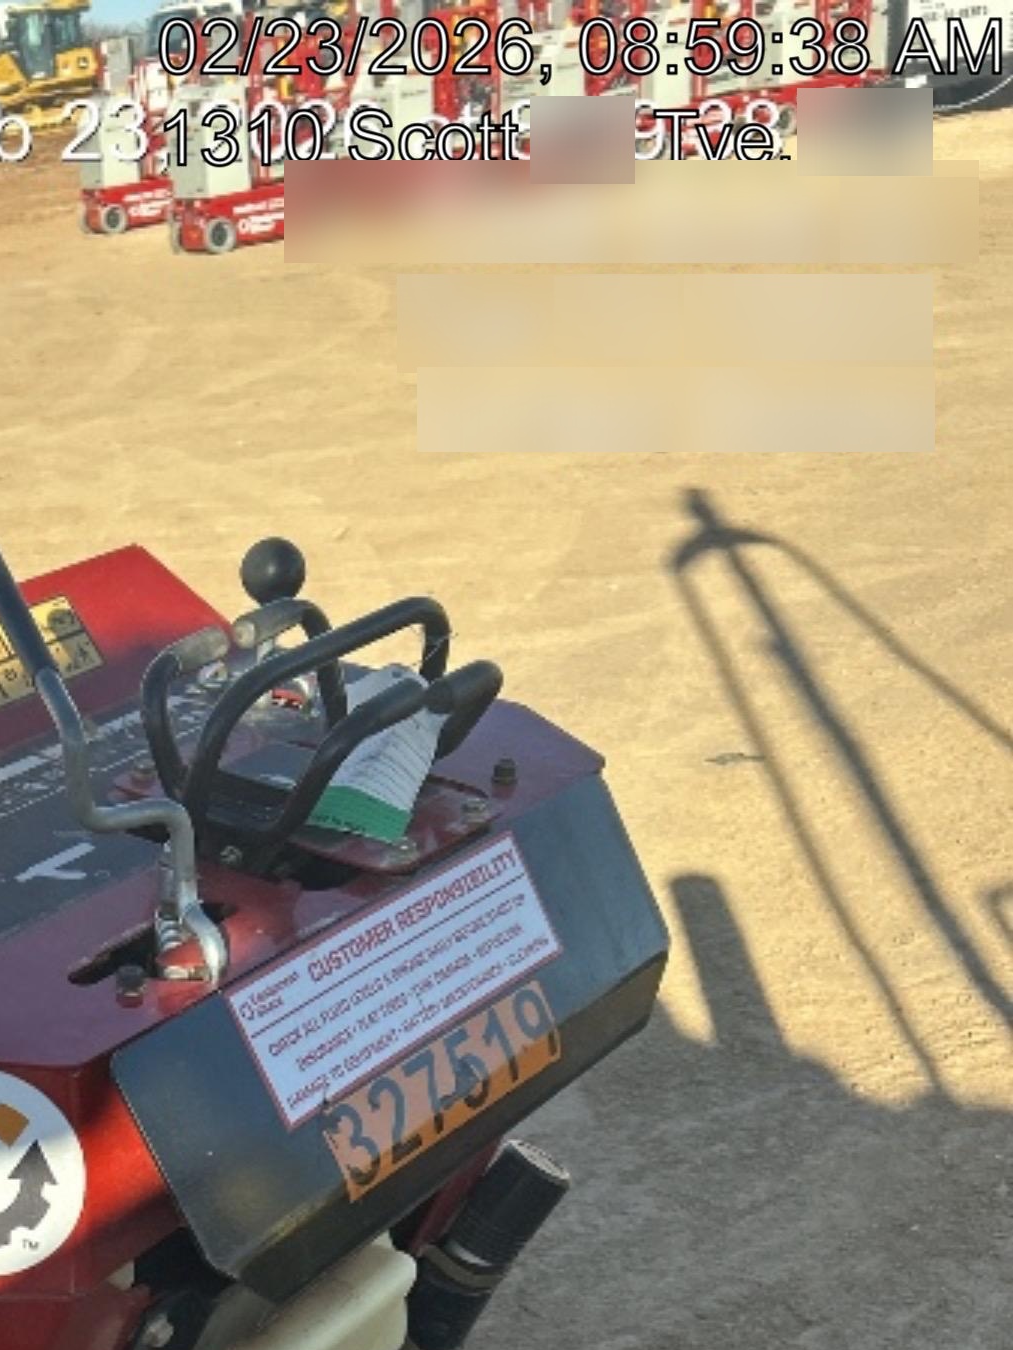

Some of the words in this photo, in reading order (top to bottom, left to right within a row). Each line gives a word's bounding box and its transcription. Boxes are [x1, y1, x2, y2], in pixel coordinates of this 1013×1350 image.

[309, 920, 393, 982] CUSTOMER
[397, 849, 516, 931] RESPONSIBILITY
[326, 997, 558, 1183] 327519
